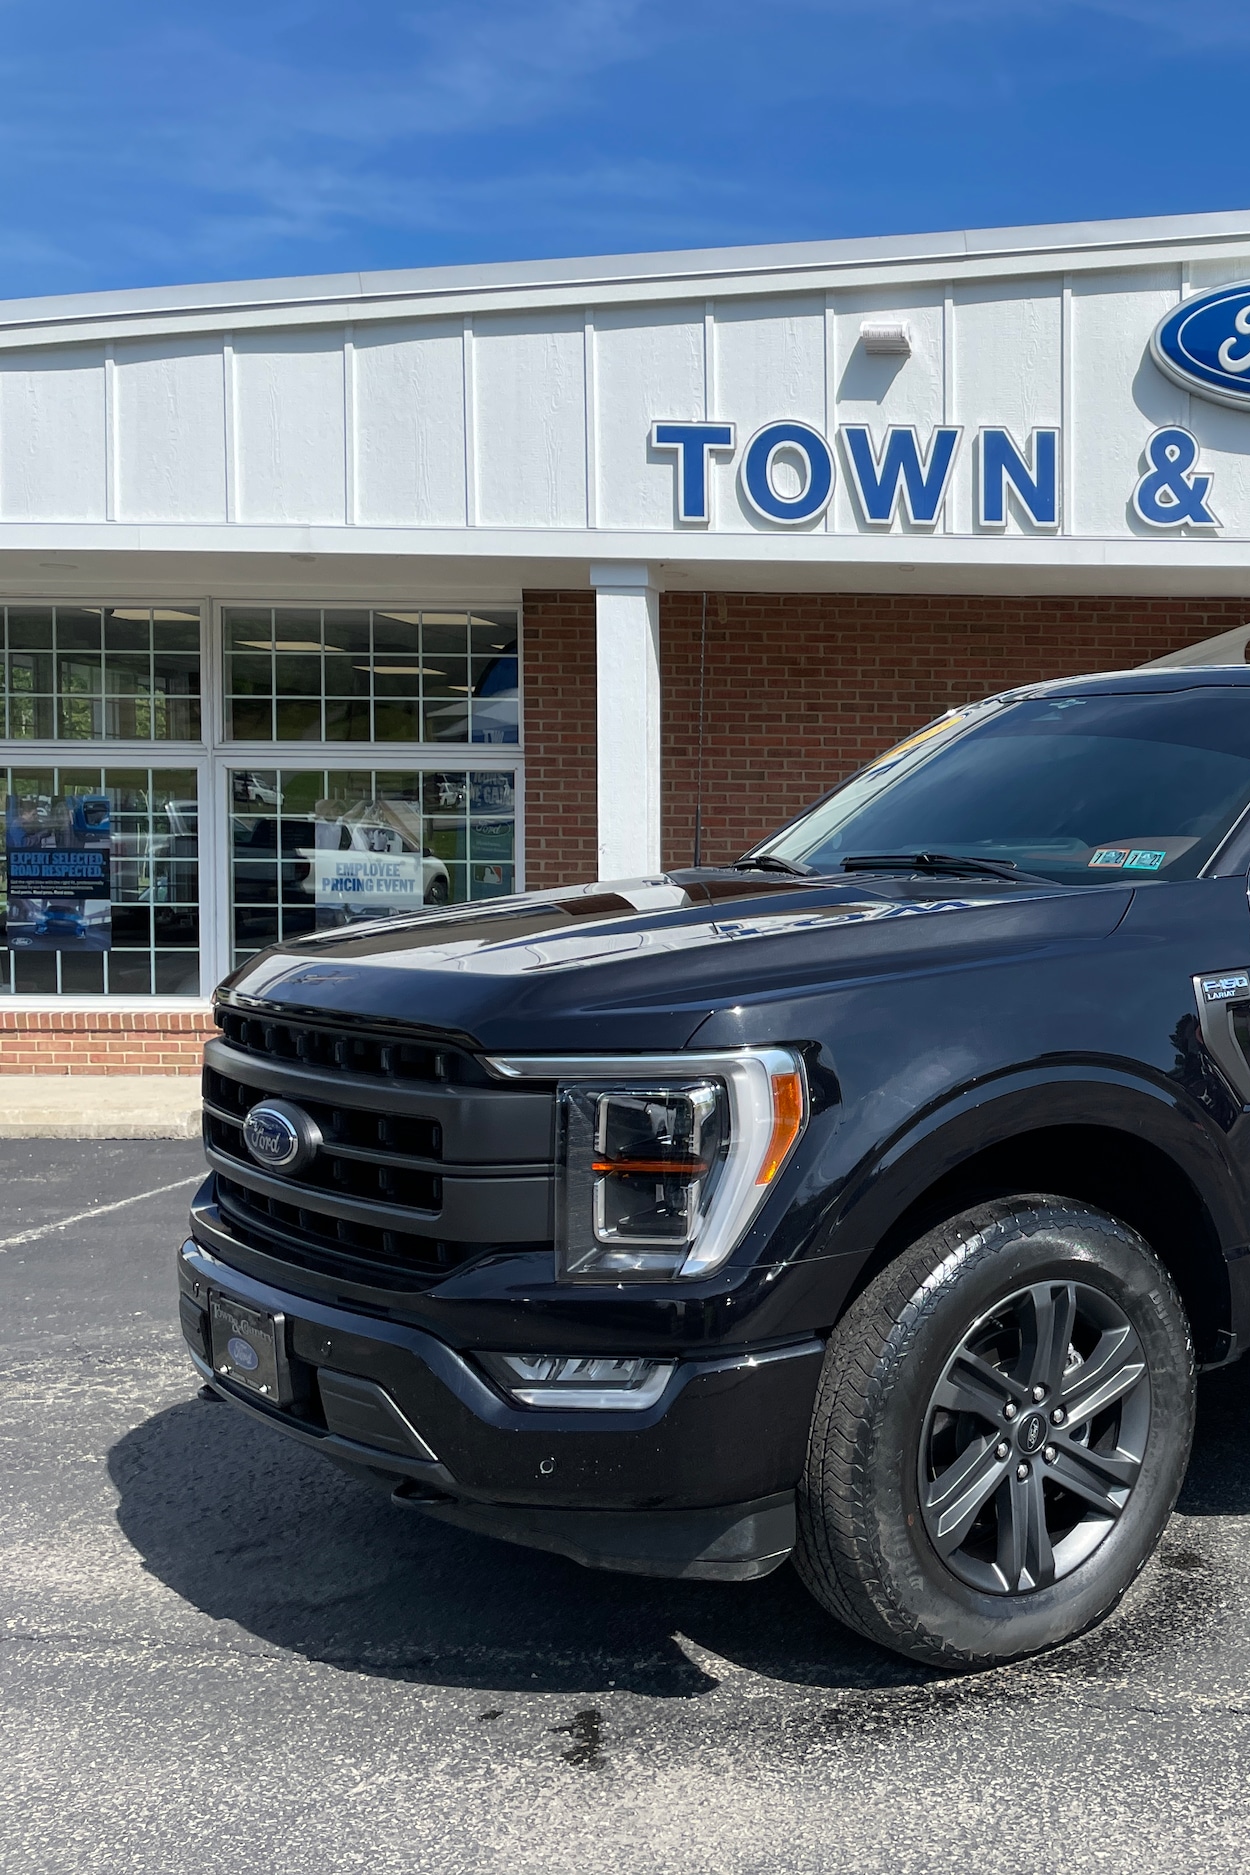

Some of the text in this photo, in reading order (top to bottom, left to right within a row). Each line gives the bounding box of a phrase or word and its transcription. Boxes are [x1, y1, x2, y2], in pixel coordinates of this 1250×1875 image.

[652, 420, 1060, 528] TOWN
[1134, 425, 1223, 529] &
[10, 852, 106, 866] EXPERT SELECTED.
[10, 865, 105, 878] ROAD RESPECTED.
[336, 863, 400, 877] EMPLOYEE
[322, 877, 415, 893] PRICING EVENT
[1203, 976, 1248, 993] F-150
[1207, 990, 1236, 1001] LARIAT
